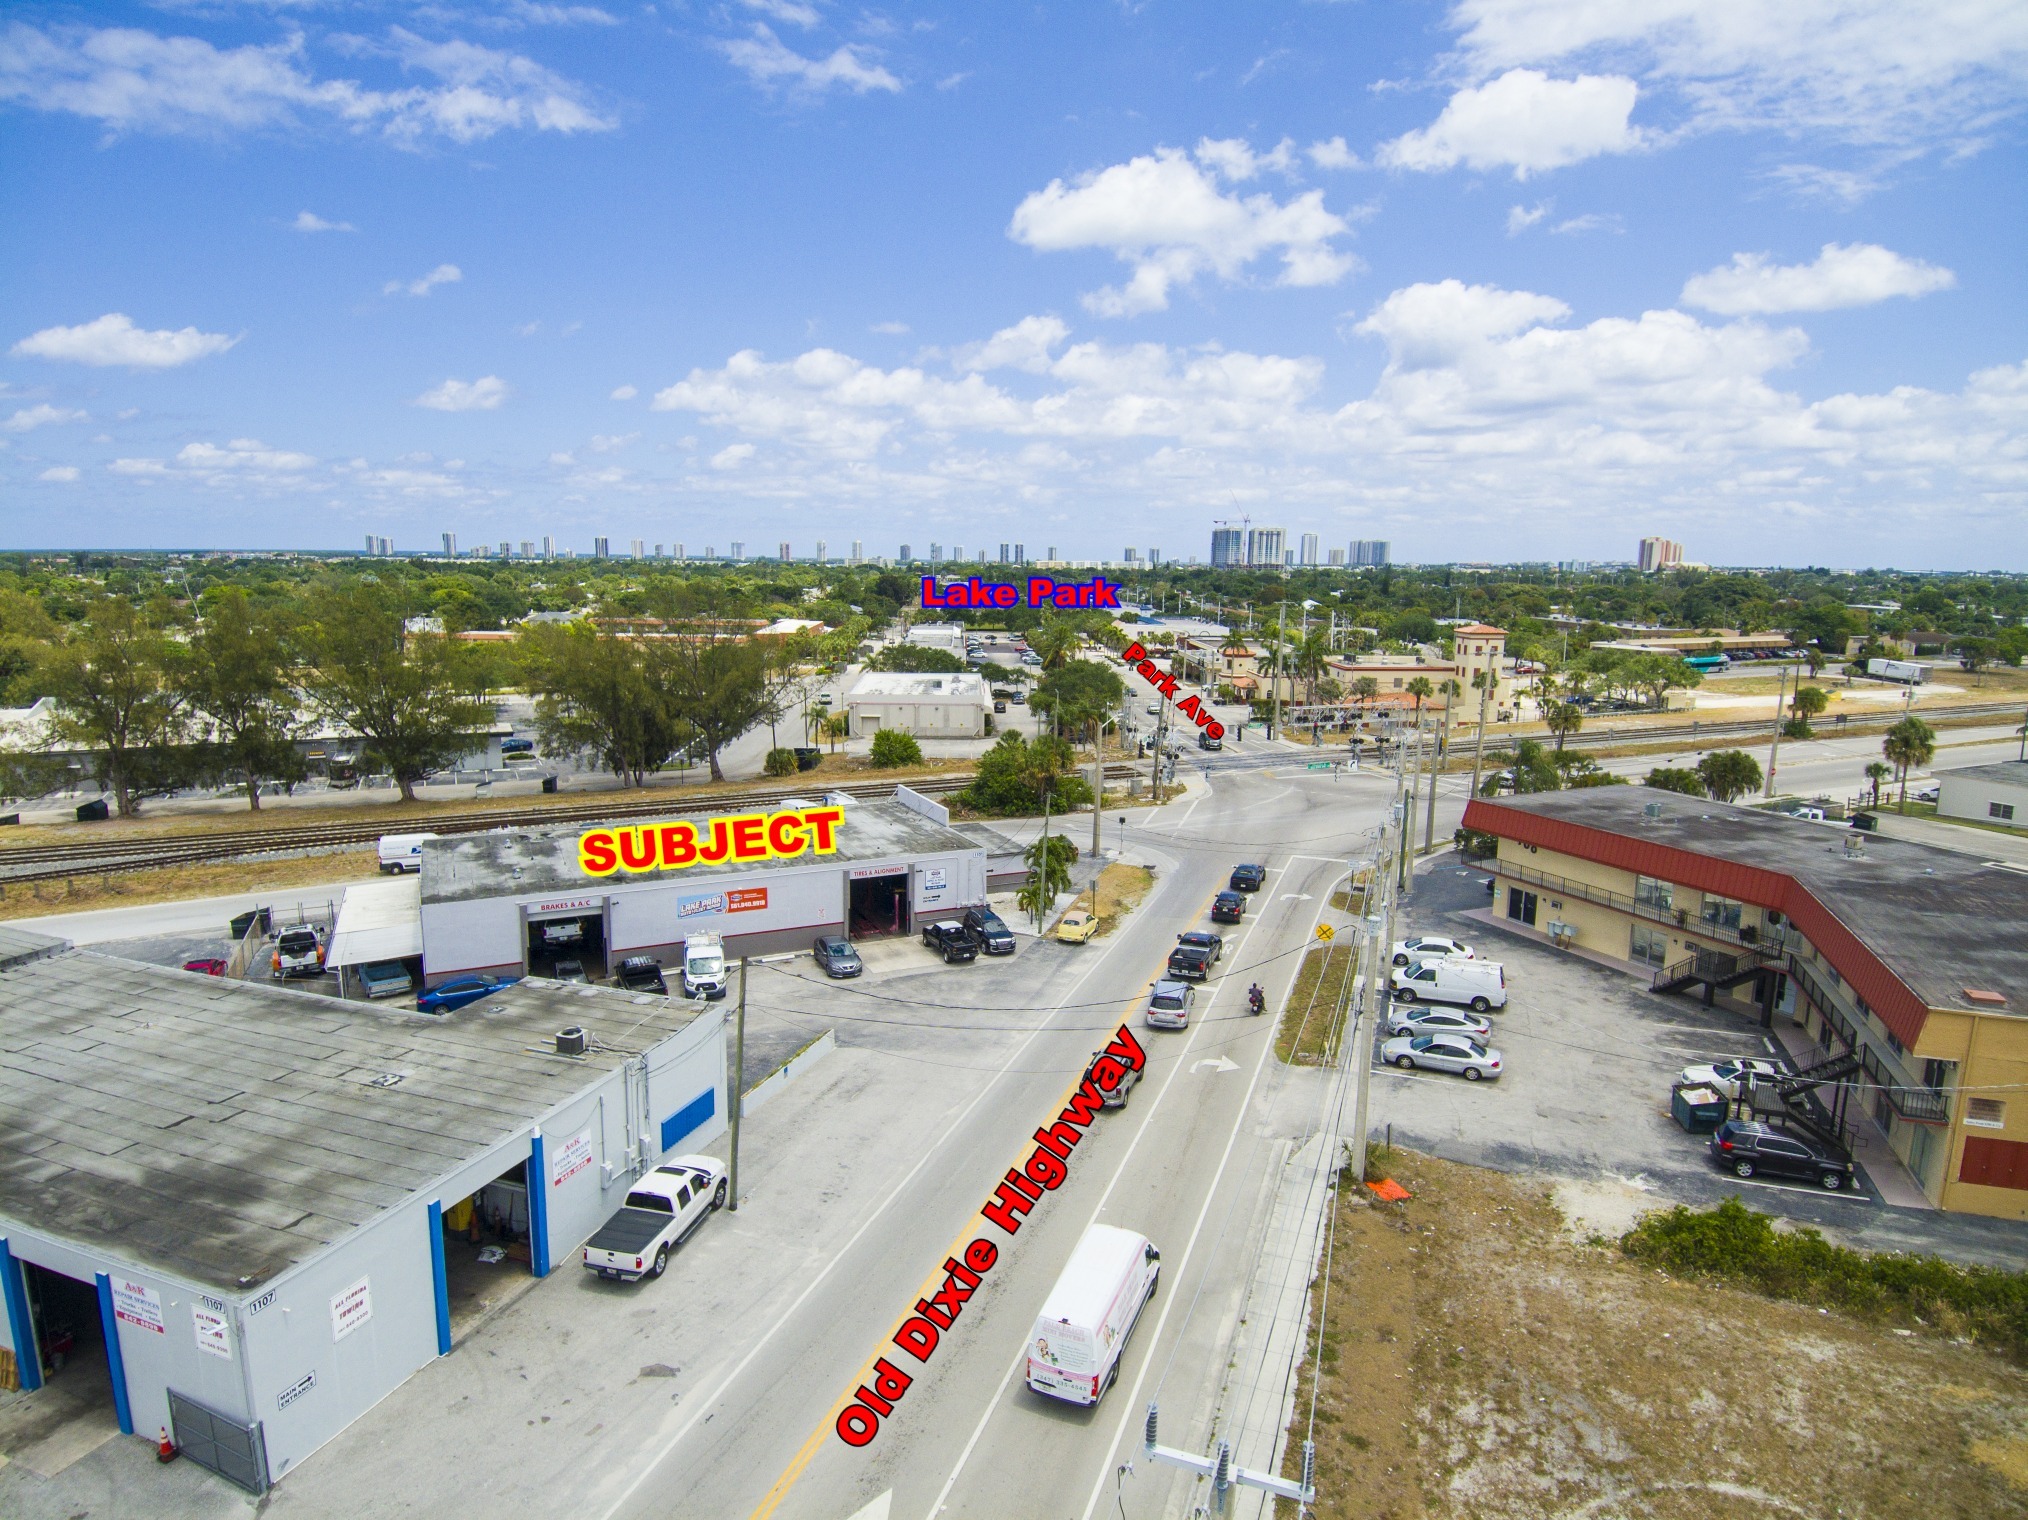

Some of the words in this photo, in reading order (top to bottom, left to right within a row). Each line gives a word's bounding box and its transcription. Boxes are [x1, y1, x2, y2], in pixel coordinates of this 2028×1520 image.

[874, 866, 904, 875] ALIGNMENT
[540, 903, 568, 911] BRAKES
[681, 901, 702, 912] LAKE
[702, 895, 722, 907] PARK
[125, 1282, 145, 1296] A&K
[206, 1298, 223, 1311] 1107
[252, 1292, 274, 1312] 1107
[335, 1299, 344, 1311] ALL
[346, 1285, 367, 1303] FLORIDA
[339, 1298, 364, 1320] TOWING
[280, 1387, 297, 1401] MAIN
[281, 1381, 314, 1407] ENTRANCE
